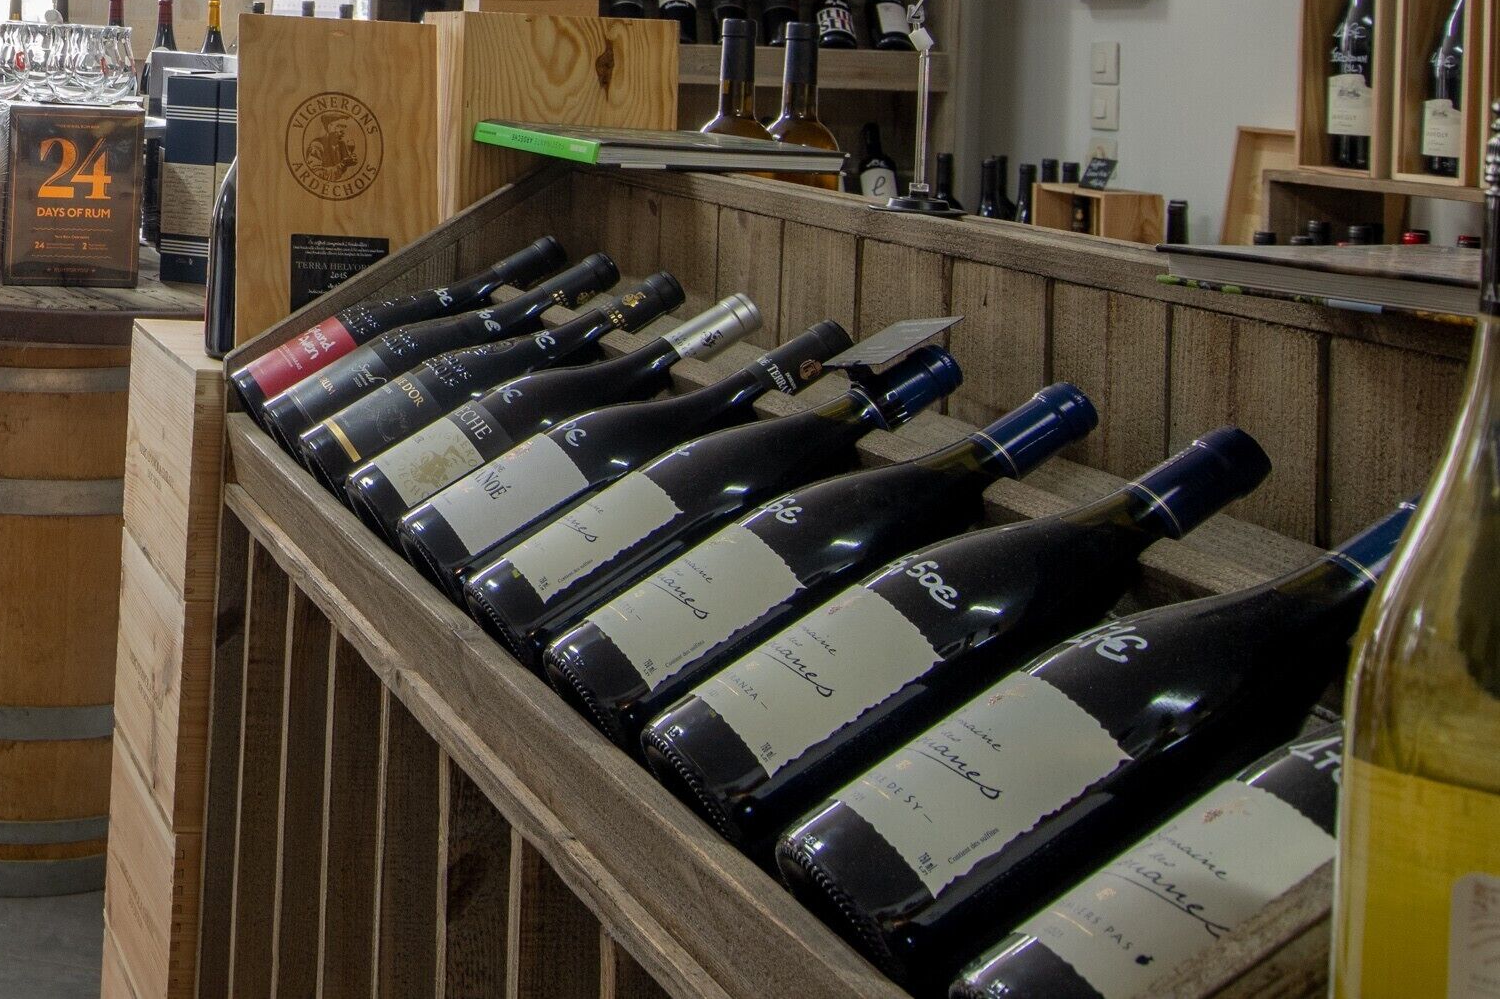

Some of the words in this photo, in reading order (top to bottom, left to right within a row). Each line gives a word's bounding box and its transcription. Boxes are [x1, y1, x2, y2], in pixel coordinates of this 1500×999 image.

[293, 96, 378, 135] VIGNERONS
[38, 137, 112, 199] 24
[37, 208, 65, 217] DAYS
[68, 208, 83, 217] OF
[85, 208, 111, 218] RUM
[35, 241, 45, 249] 24
[296, 261, 328, 270] TERRA
[948, 847, 973, 864] Contient
[1103, 924, 1134, 951] PAS
